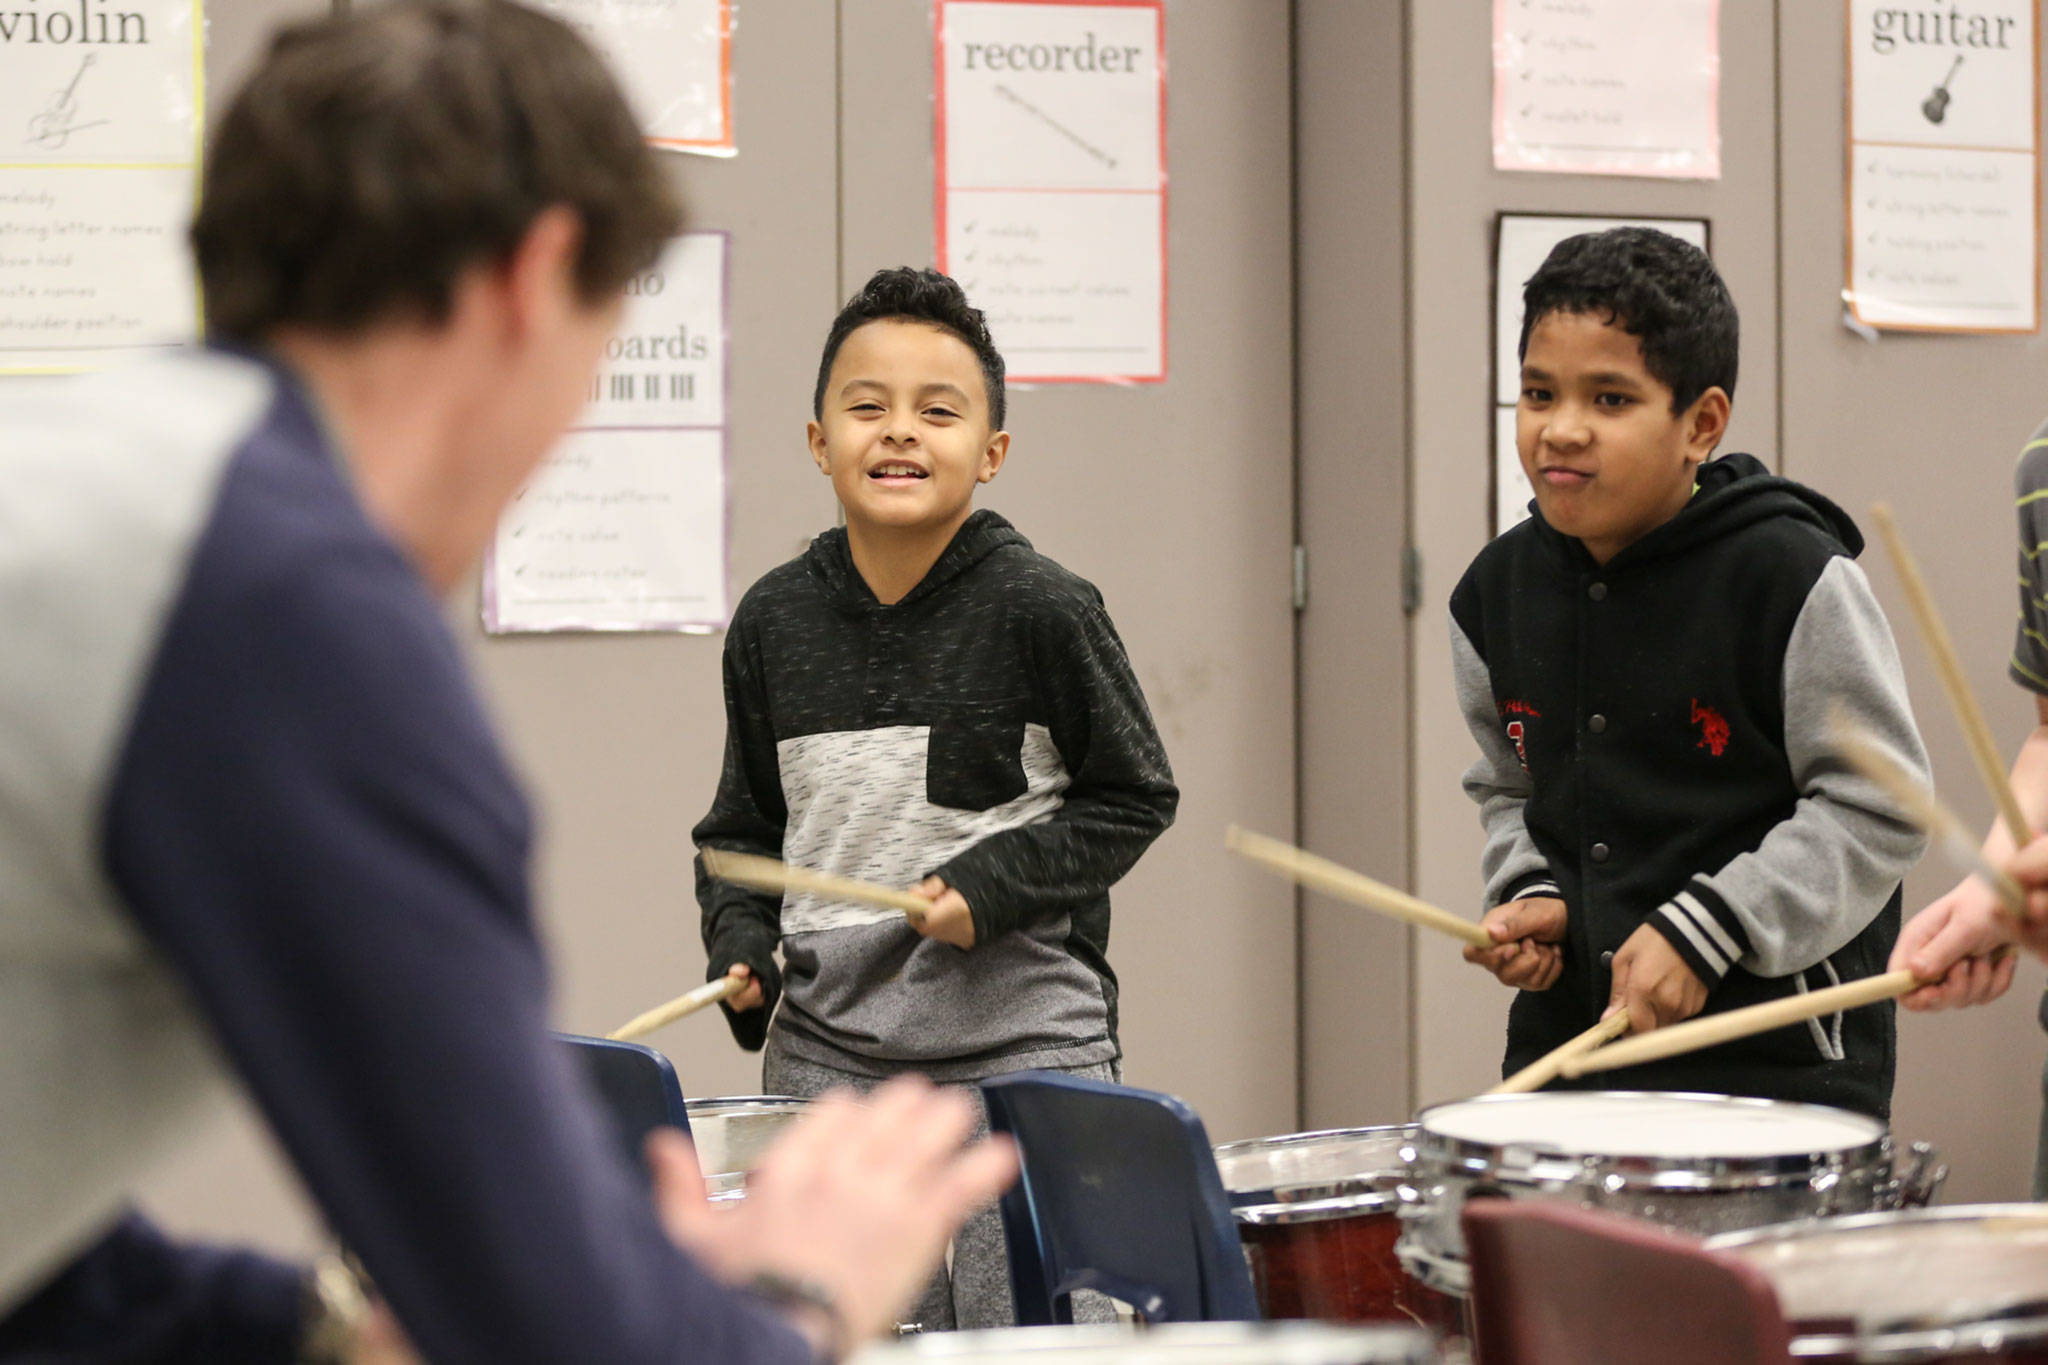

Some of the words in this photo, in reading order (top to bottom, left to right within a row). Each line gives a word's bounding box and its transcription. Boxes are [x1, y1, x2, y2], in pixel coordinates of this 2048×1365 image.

[0, 0, 150, 44] violin
[1872, 0, 2016, 55] guitar
[963, 31, 1142, 74] recorder
[604, 322, 711, 361] oards
